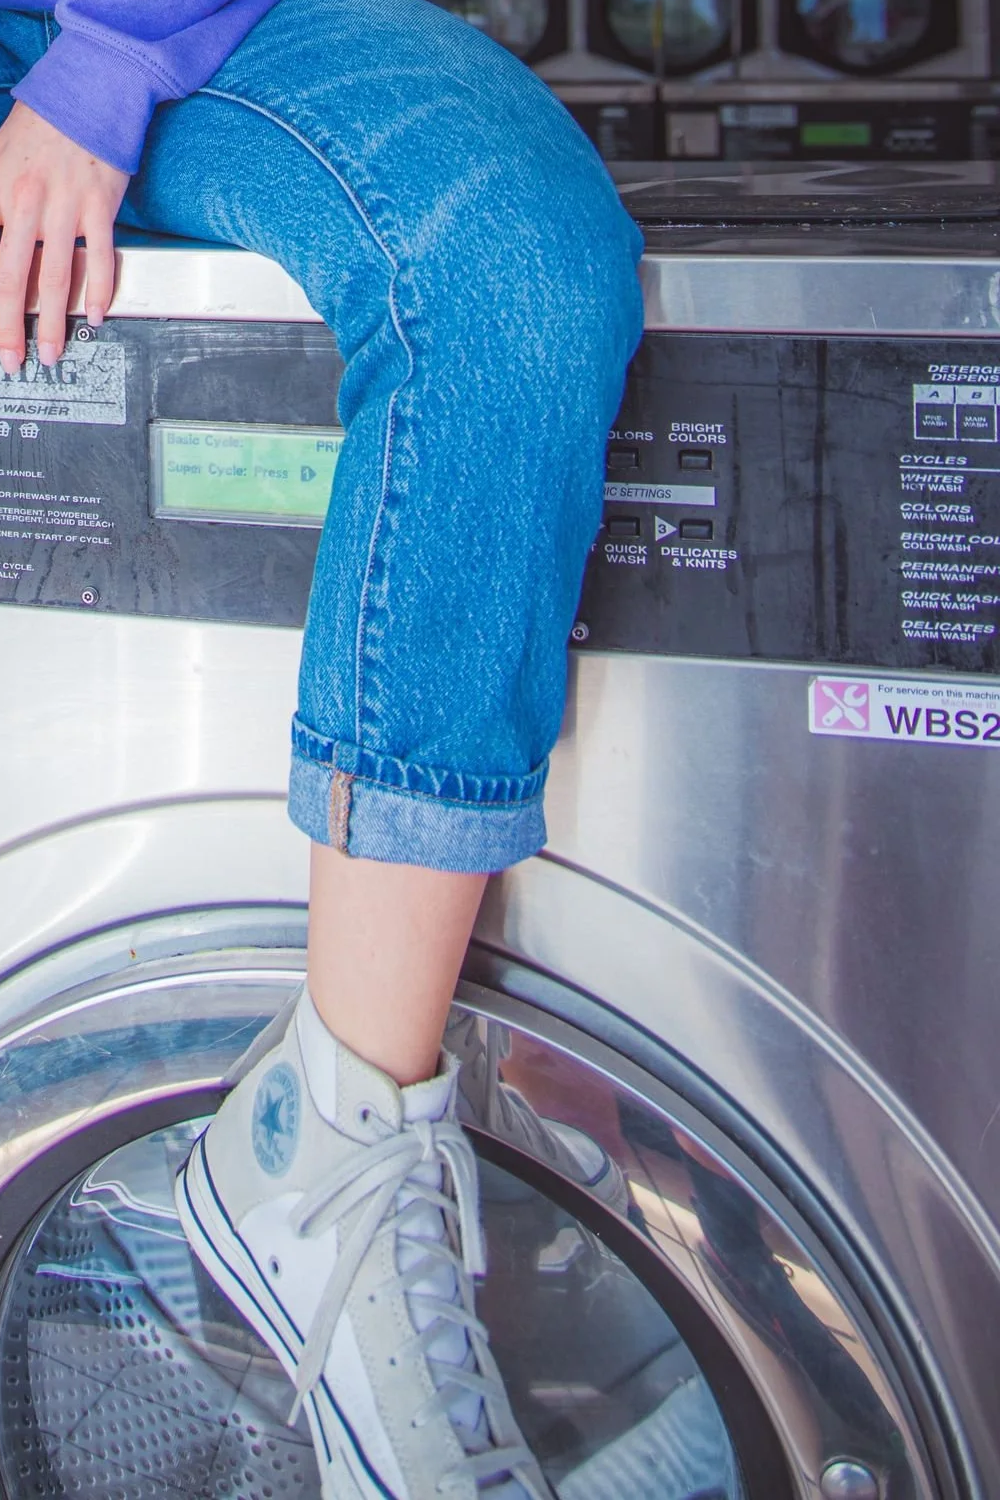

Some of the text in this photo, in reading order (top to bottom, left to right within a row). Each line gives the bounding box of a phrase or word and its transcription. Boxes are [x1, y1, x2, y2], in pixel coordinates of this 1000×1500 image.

[1, 403, 70, 416] WASHER
[671, 423, 723, 433] BRIGHT
[608, 431, 654, 441] OLORS
[668, 433, 727, 444] COLORS
[167, 433, 341, 452] Basic Cycle: PRI
[900, 455, 967, 465] CYCLES
[7, 470, 45, 478] HANDLE.
[167, 461, 201, 474] Super
[208, 464, 247, 477] Cycle:
[254, 467, 288, 479] Press
[900, 473, 964, 484] WHITES
[620, 487, 672, 499] SETTINGS
[928, 484, 962, 492] WASH
[14, 492, 57, 501] PREWASH
[73, 496, 101, 504] START
[900, 503, 971, 513] COLORS
[48, 511, 99, 520] POWDERED
[902, 512, 974, 522] WARM WASH
[78, 520, 114, 528] BLEACH
[658, 524, 667, 534] 3
[80, 536, 112, 544] CYCLE.
[900, 532, 965, 543] BRIGHT
[604, 544, 648, 554] QUICK
[902, 542, 971, 552] COLD WASH
[661, 547, 737, 559] DELICATES
[606, 555, 646, 565] WASH
[672, 559, 727, 569] & KNITS
[2, 562, 34, 571] CYCLE.
[902, 571, 974, 582] WARM WASH
[902, 591, 952, 601] QUICK
[903, 600, 975, 611] WARM WASH
[901, 620, 995, 633] DELICATES
[903, 630, 976, 641] WARM WASH
[878, 684, 894, 693] For
[896, 686, 929, 696] service
[932, 689, 944, 697] on
[946, 689, 963, 698] this
[885, 705, 1000, 741] WBS2
